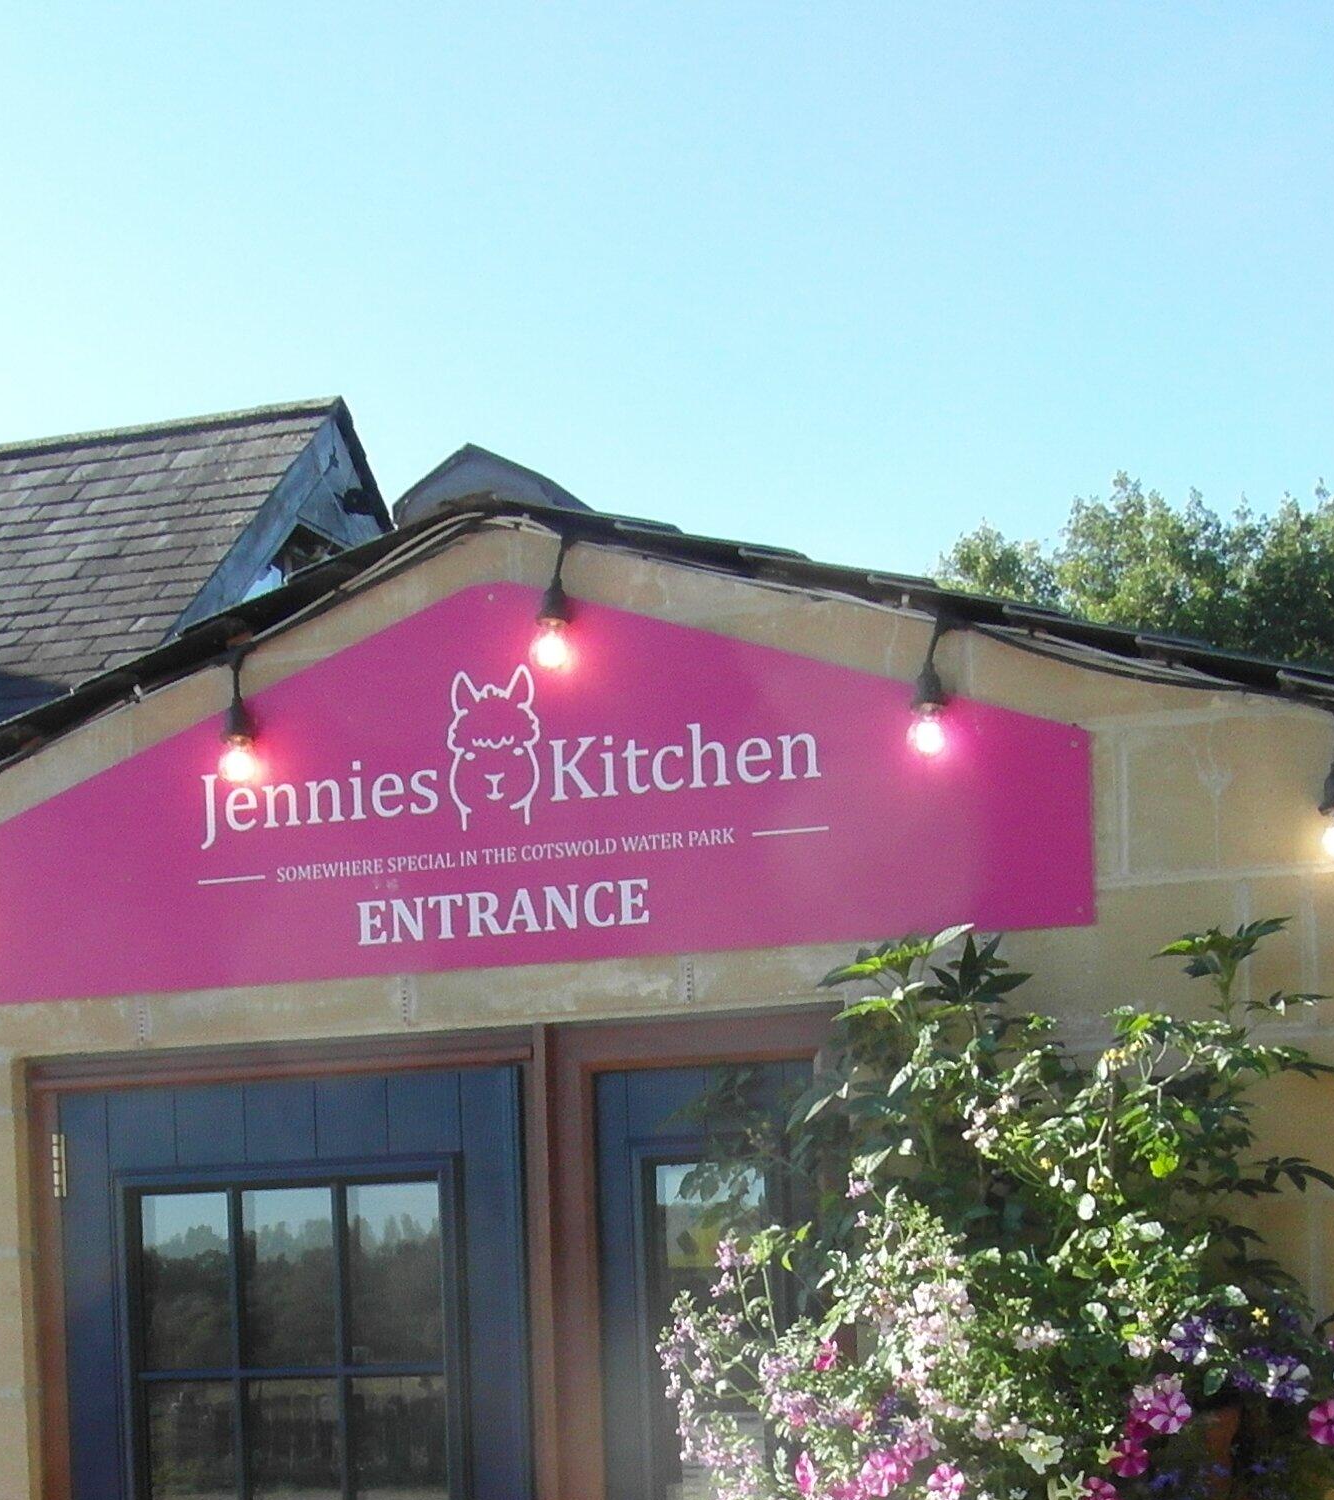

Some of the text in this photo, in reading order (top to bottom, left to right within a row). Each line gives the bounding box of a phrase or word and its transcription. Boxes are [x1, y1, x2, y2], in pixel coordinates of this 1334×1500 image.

[200, 722, 823, 851] Jennies Kitchen
[276, 827, 735, 883] SOMEWHERE SPECIAL IN THE COTSWOLD WATER PARK
[356, 878, 651, 946] ENTRANCE
